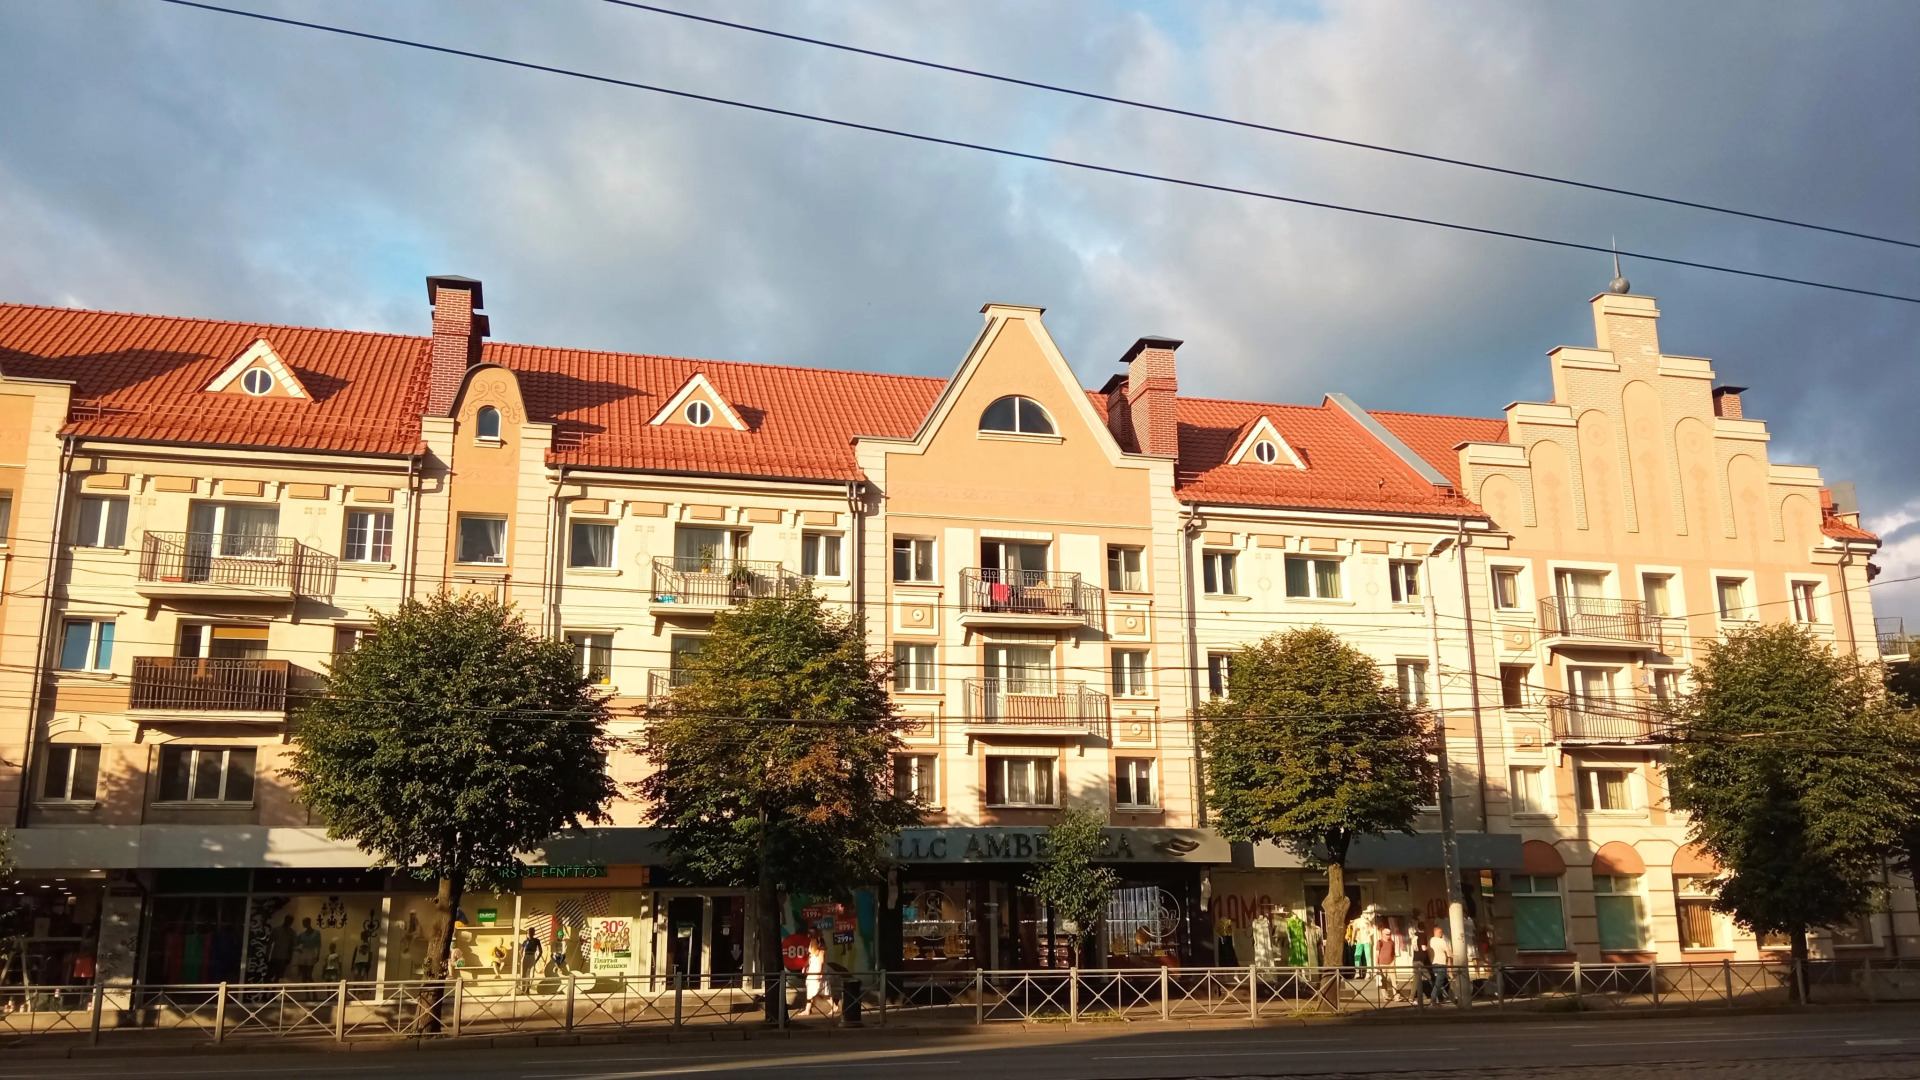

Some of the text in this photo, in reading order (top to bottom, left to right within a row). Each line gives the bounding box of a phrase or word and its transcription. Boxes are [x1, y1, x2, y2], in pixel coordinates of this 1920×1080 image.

[896, 838, 948, 859] LLC
[961, 833, 1072, 858] AMBE
[521, 867, 537, 878] OF
[542, 867, 606, 878] BENETTON
[594, 920, 630, 935] -30%
[599, 963, 627, 971] рубашки
